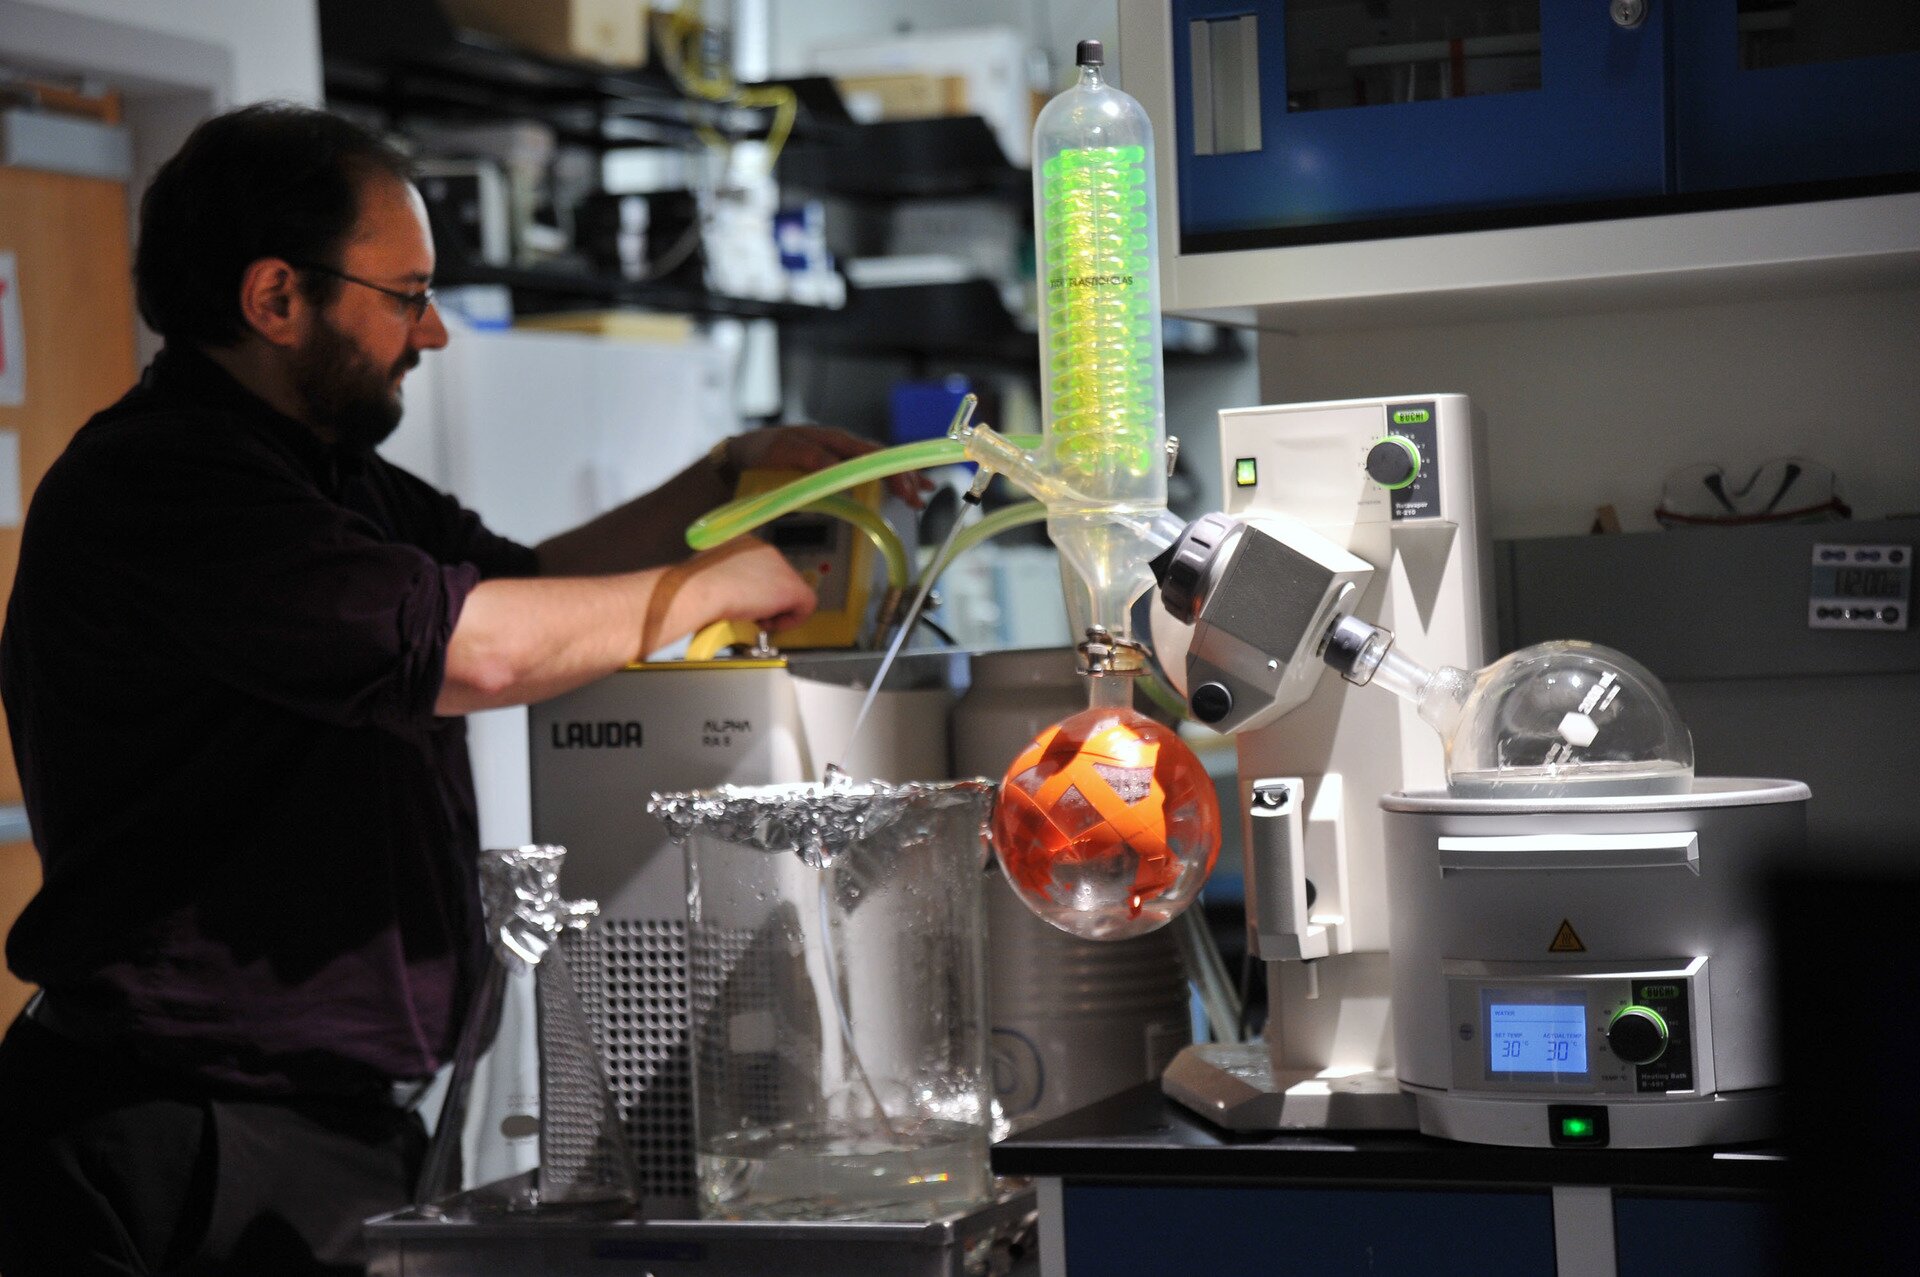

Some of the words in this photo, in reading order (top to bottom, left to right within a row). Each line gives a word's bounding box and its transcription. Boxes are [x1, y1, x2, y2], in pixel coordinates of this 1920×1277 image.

[551, 720, 643, 749] LAUDA
[1501, 1041, 1521, 1058] 30
[1546, 1041, 1569, 1061] 30
